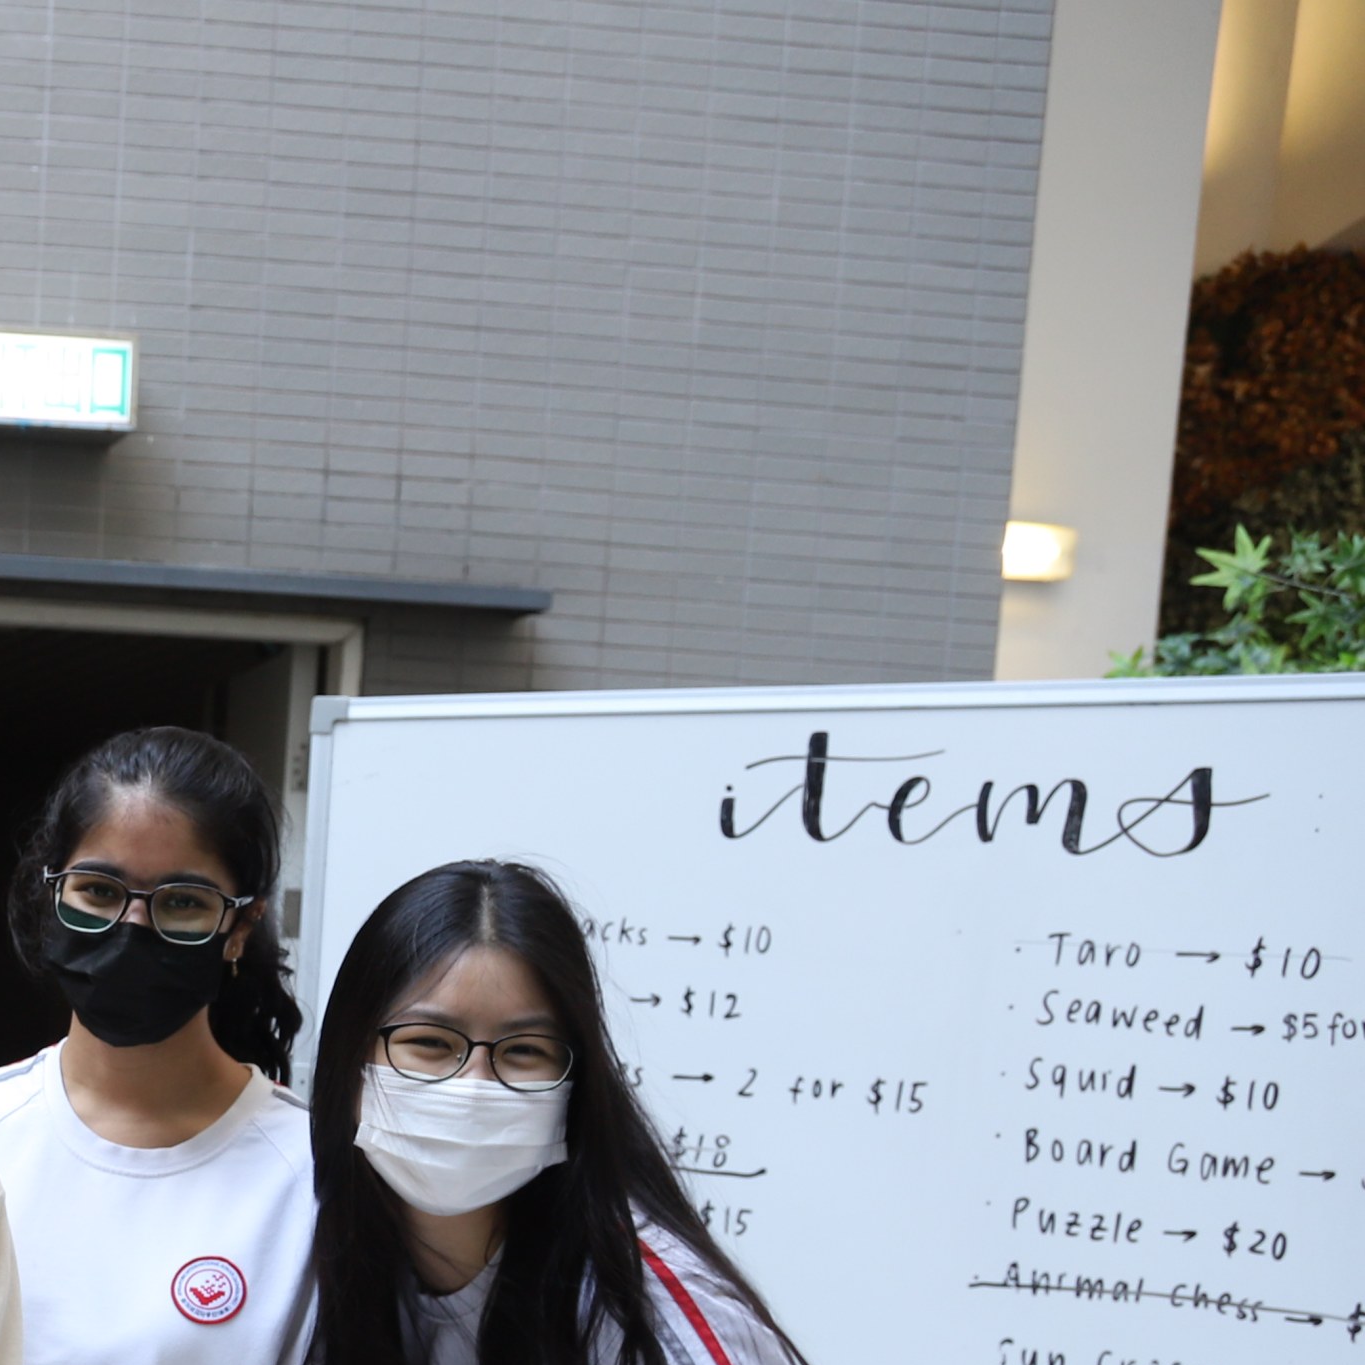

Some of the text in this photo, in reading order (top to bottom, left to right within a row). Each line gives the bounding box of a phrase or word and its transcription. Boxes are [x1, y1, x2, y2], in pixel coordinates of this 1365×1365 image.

[719, 731, 1271, 858] items
[718, 923, 772, 958] $10
[1048, 932, 1323, 980] Taro $10
[681, 986, 742, 1020] $12
[1036, 990, 1206, 1041] Seaweed
[736, 1068, 758, 1098] 2
[789, 1076, 845, 1104] for
[867, 1078, 929, 1116] $15
[1024, 1057, 1282, 1111] Squid $10
[1024, 1128, 1276, 1185] Board Game
[1011, 1197, 1289, 1260] Puzzle $20
[1003, 1261, 1145, 1303] Animal
